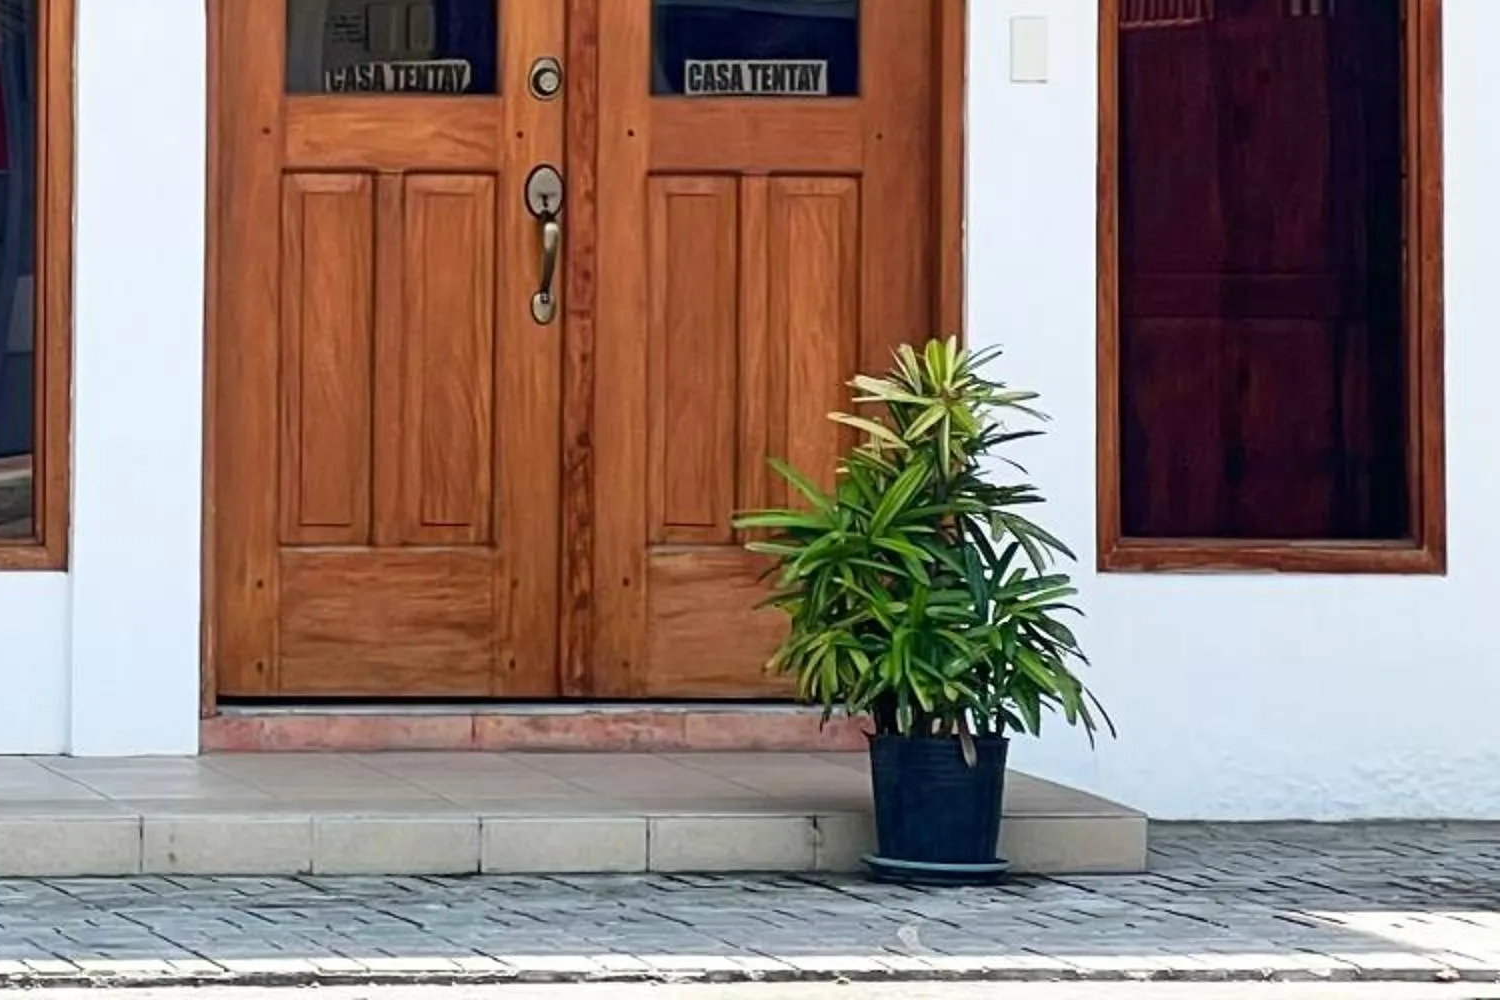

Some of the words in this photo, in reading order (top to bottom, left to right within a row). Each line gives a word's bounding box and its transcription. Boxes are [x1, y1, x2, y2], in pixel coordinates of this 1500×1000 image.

[329, 62, 385, 91] CASA
[390, 62, 467, 92] TENTAY
[687, 62, 743, 92] CASA
[747, 62, 822, 92] TENTAY
